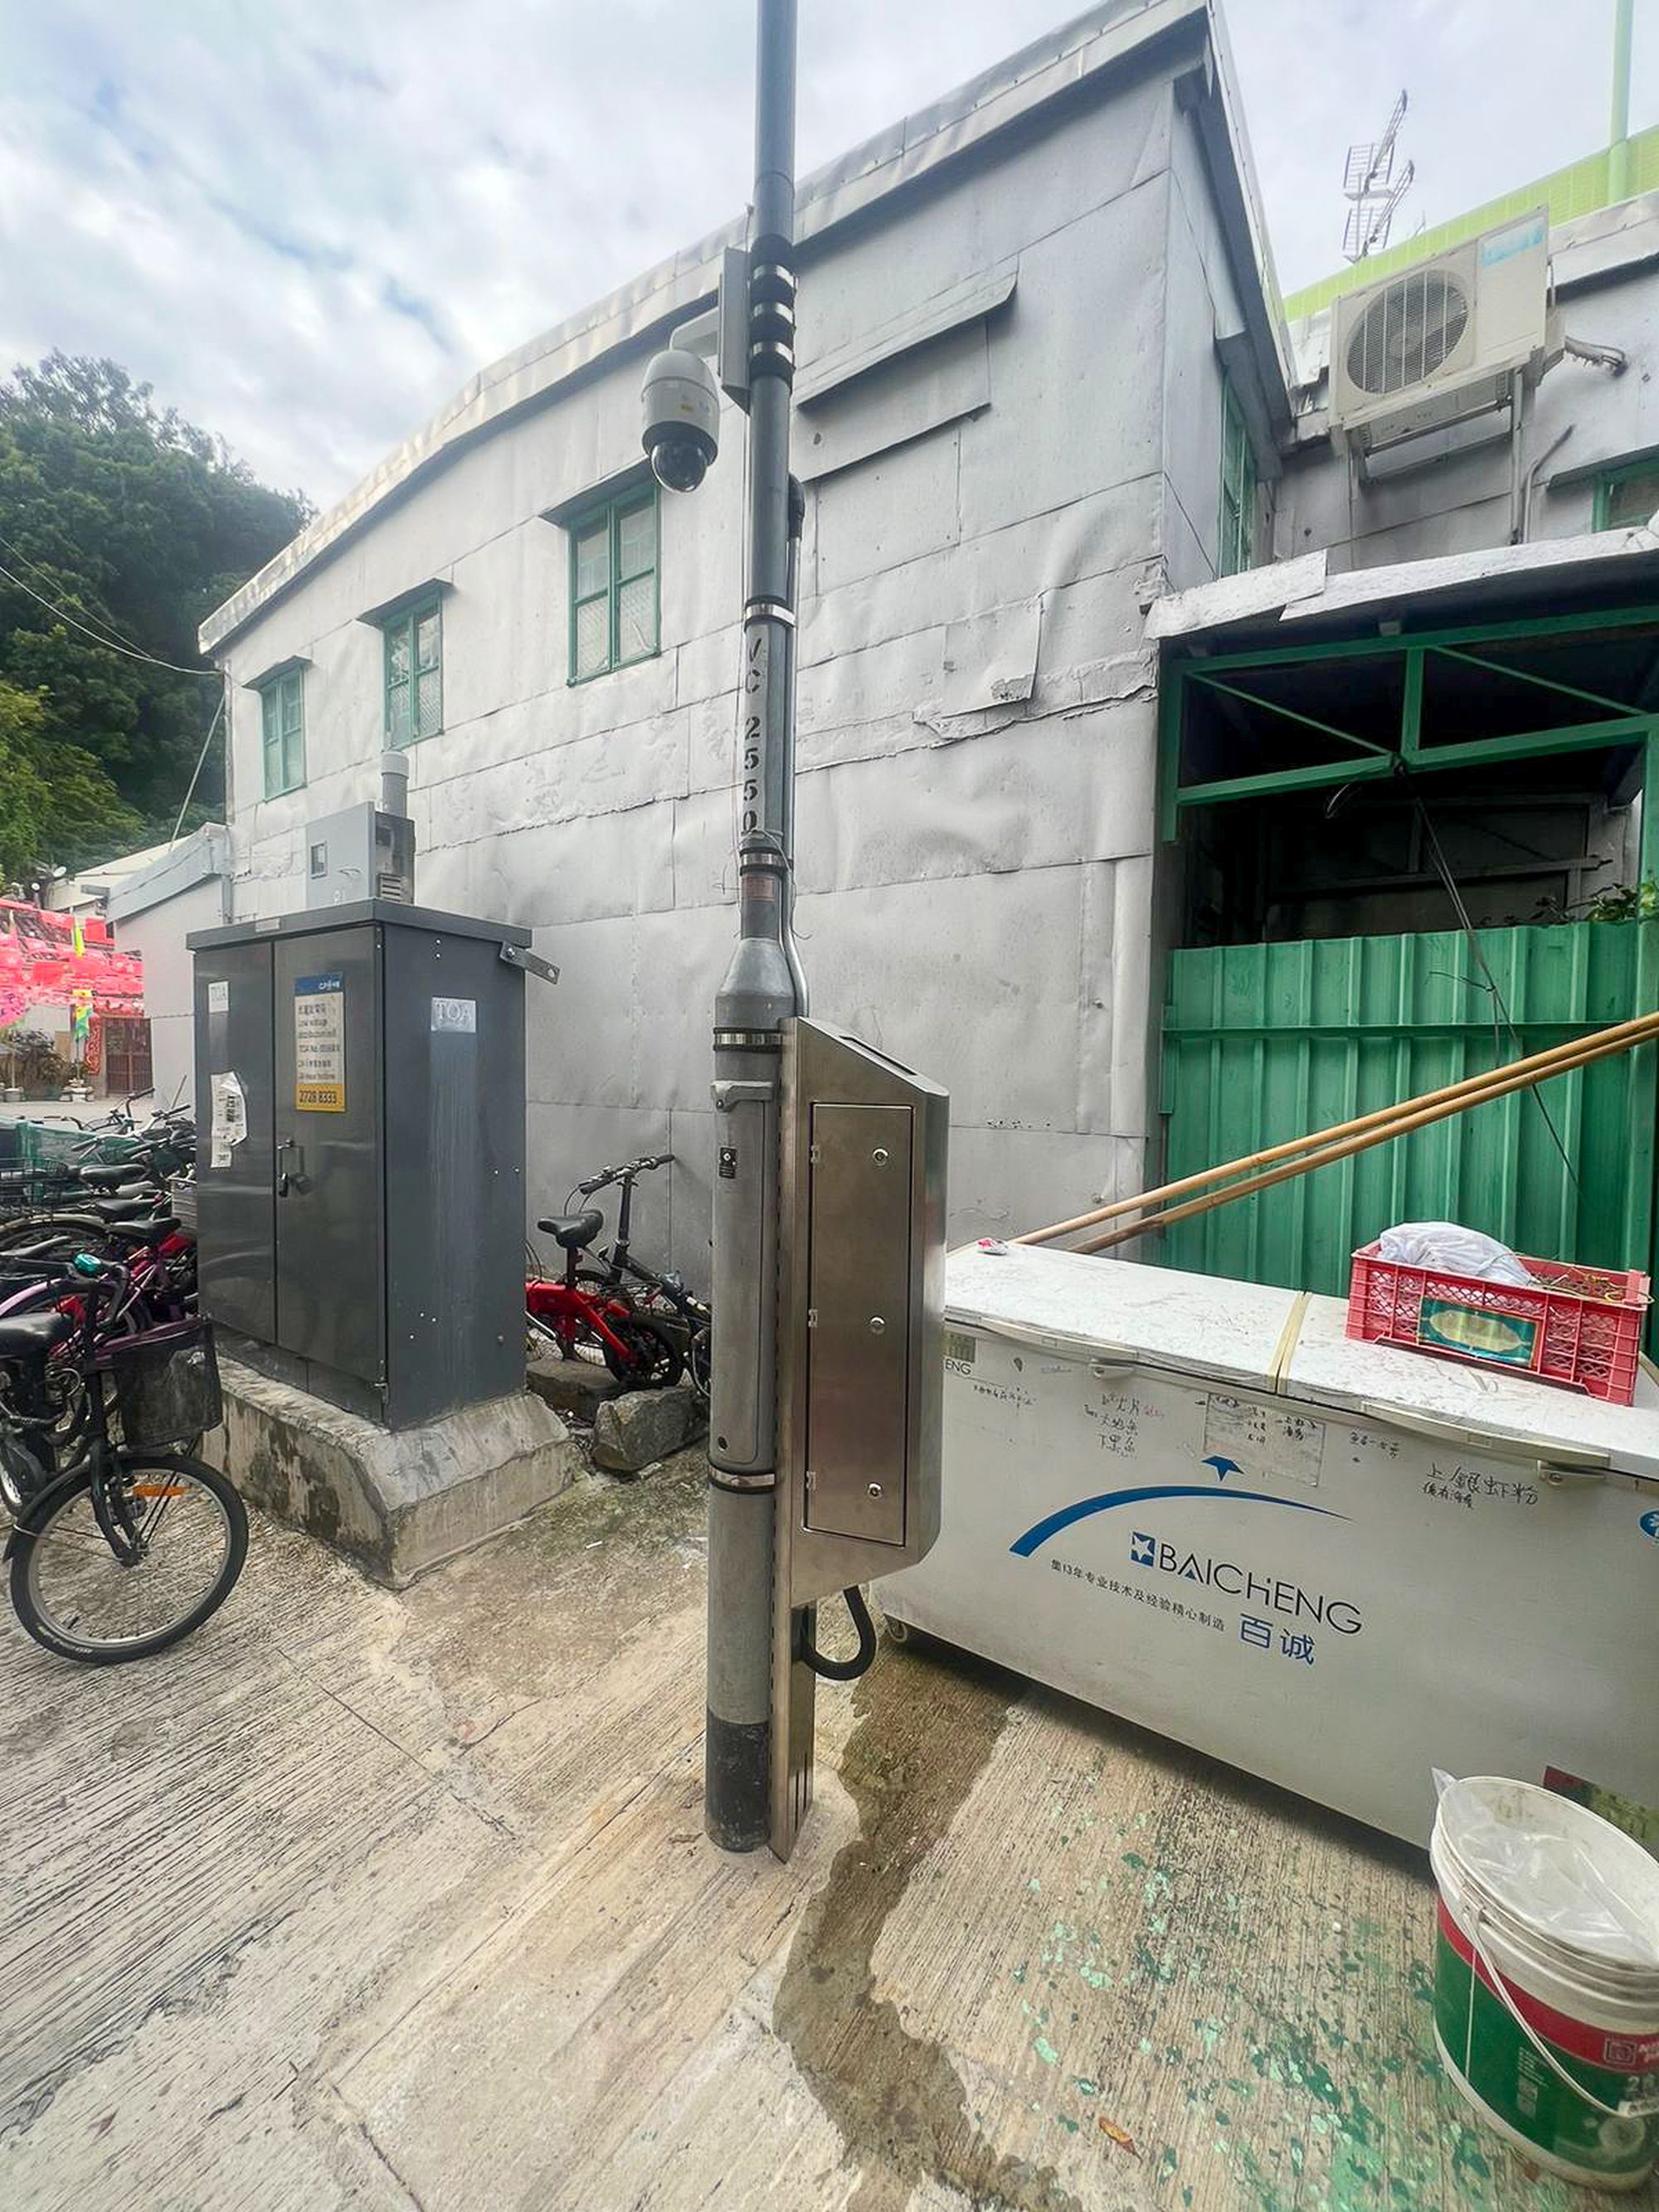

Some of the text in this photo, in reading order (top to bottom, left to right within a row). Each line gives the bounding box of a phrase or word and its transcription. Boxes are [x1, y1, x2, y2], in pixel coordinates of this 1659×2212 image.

[742, 716, 761, 833] 2550
[1159, 1543, 1363, 1635] BAICHENG
[1239, 1612, 1316, 1665] 百诚
